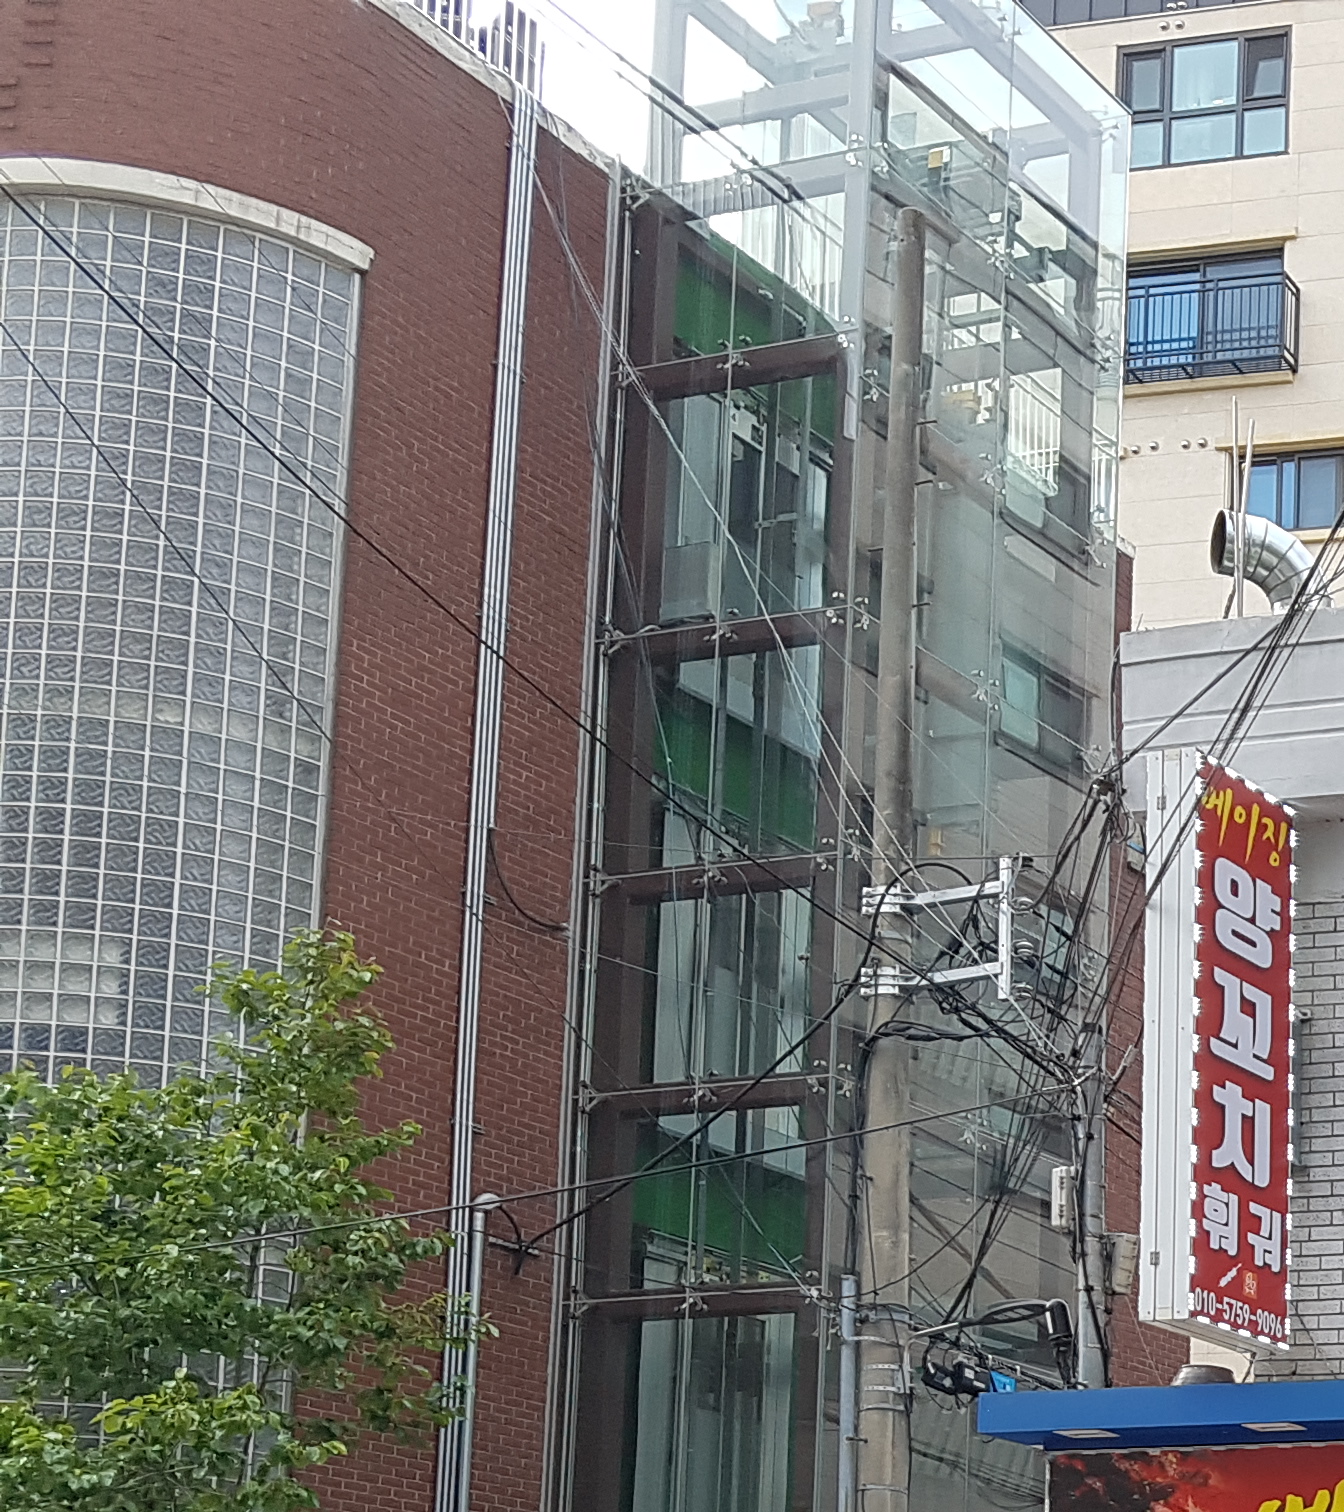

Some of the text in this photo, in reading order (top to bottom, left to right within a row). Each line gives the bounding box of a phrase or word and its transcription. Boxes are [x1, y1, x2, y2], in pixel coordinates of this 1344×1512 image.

[1202, 786, 1290, 867] 베이징
[1209, 856, 1281, 1188] 양꼬치
[1203, 1182, 1282, 1273] 훠궈
[1194, 1288, 1283, 1338] 010-5759-9096
